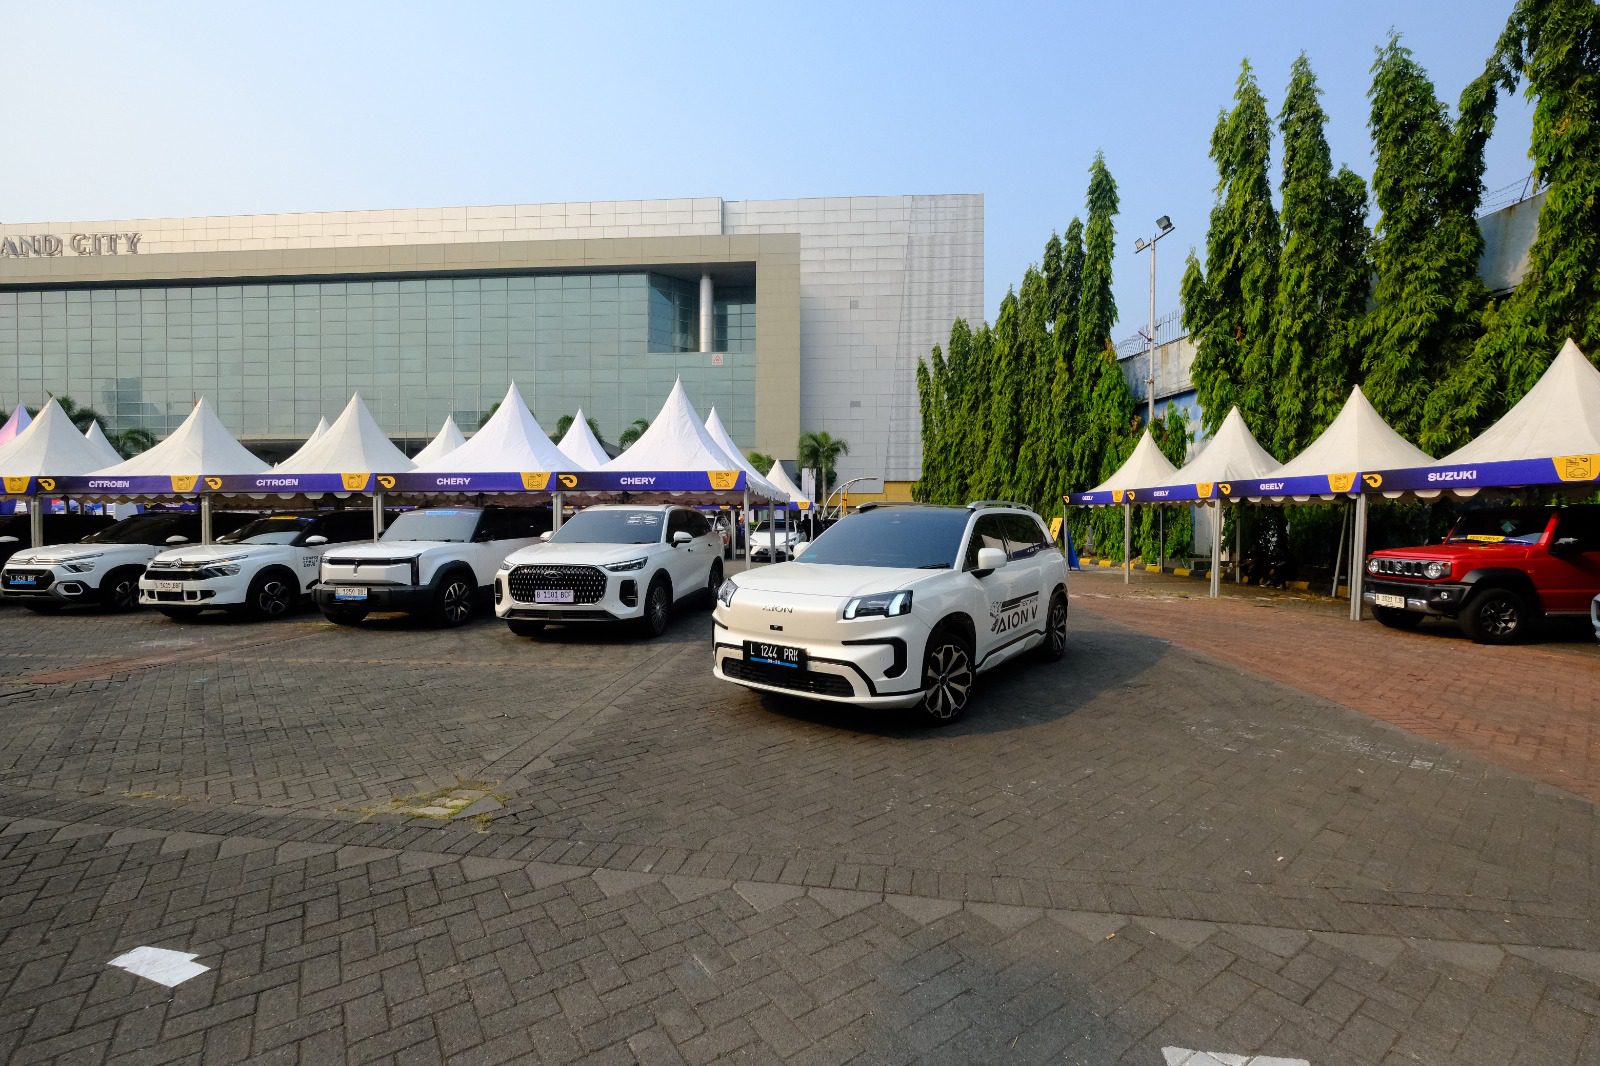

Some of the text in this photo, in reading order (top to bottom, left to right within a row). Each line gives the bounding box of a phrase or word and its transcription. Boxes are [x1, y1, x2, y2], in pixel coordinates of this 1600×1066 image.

[70, 232, 142, 256] CITY
[620, 476, 656, 485] CHERY
[1428, 470, 1477, 482] SUZUKI
[88, 480, 130, 488] CITROEN
[256, 478, 299, 487] CITROEN
[436, 477, 471, 486] CHERY
[1259, 482, 1284, 491] GEELY
[996, 604, 1038, 634] AION V
[750, 643, 755, 655] L
[760, 644, 778, 659] 1244
[783, 648, 799, 662] PRK
